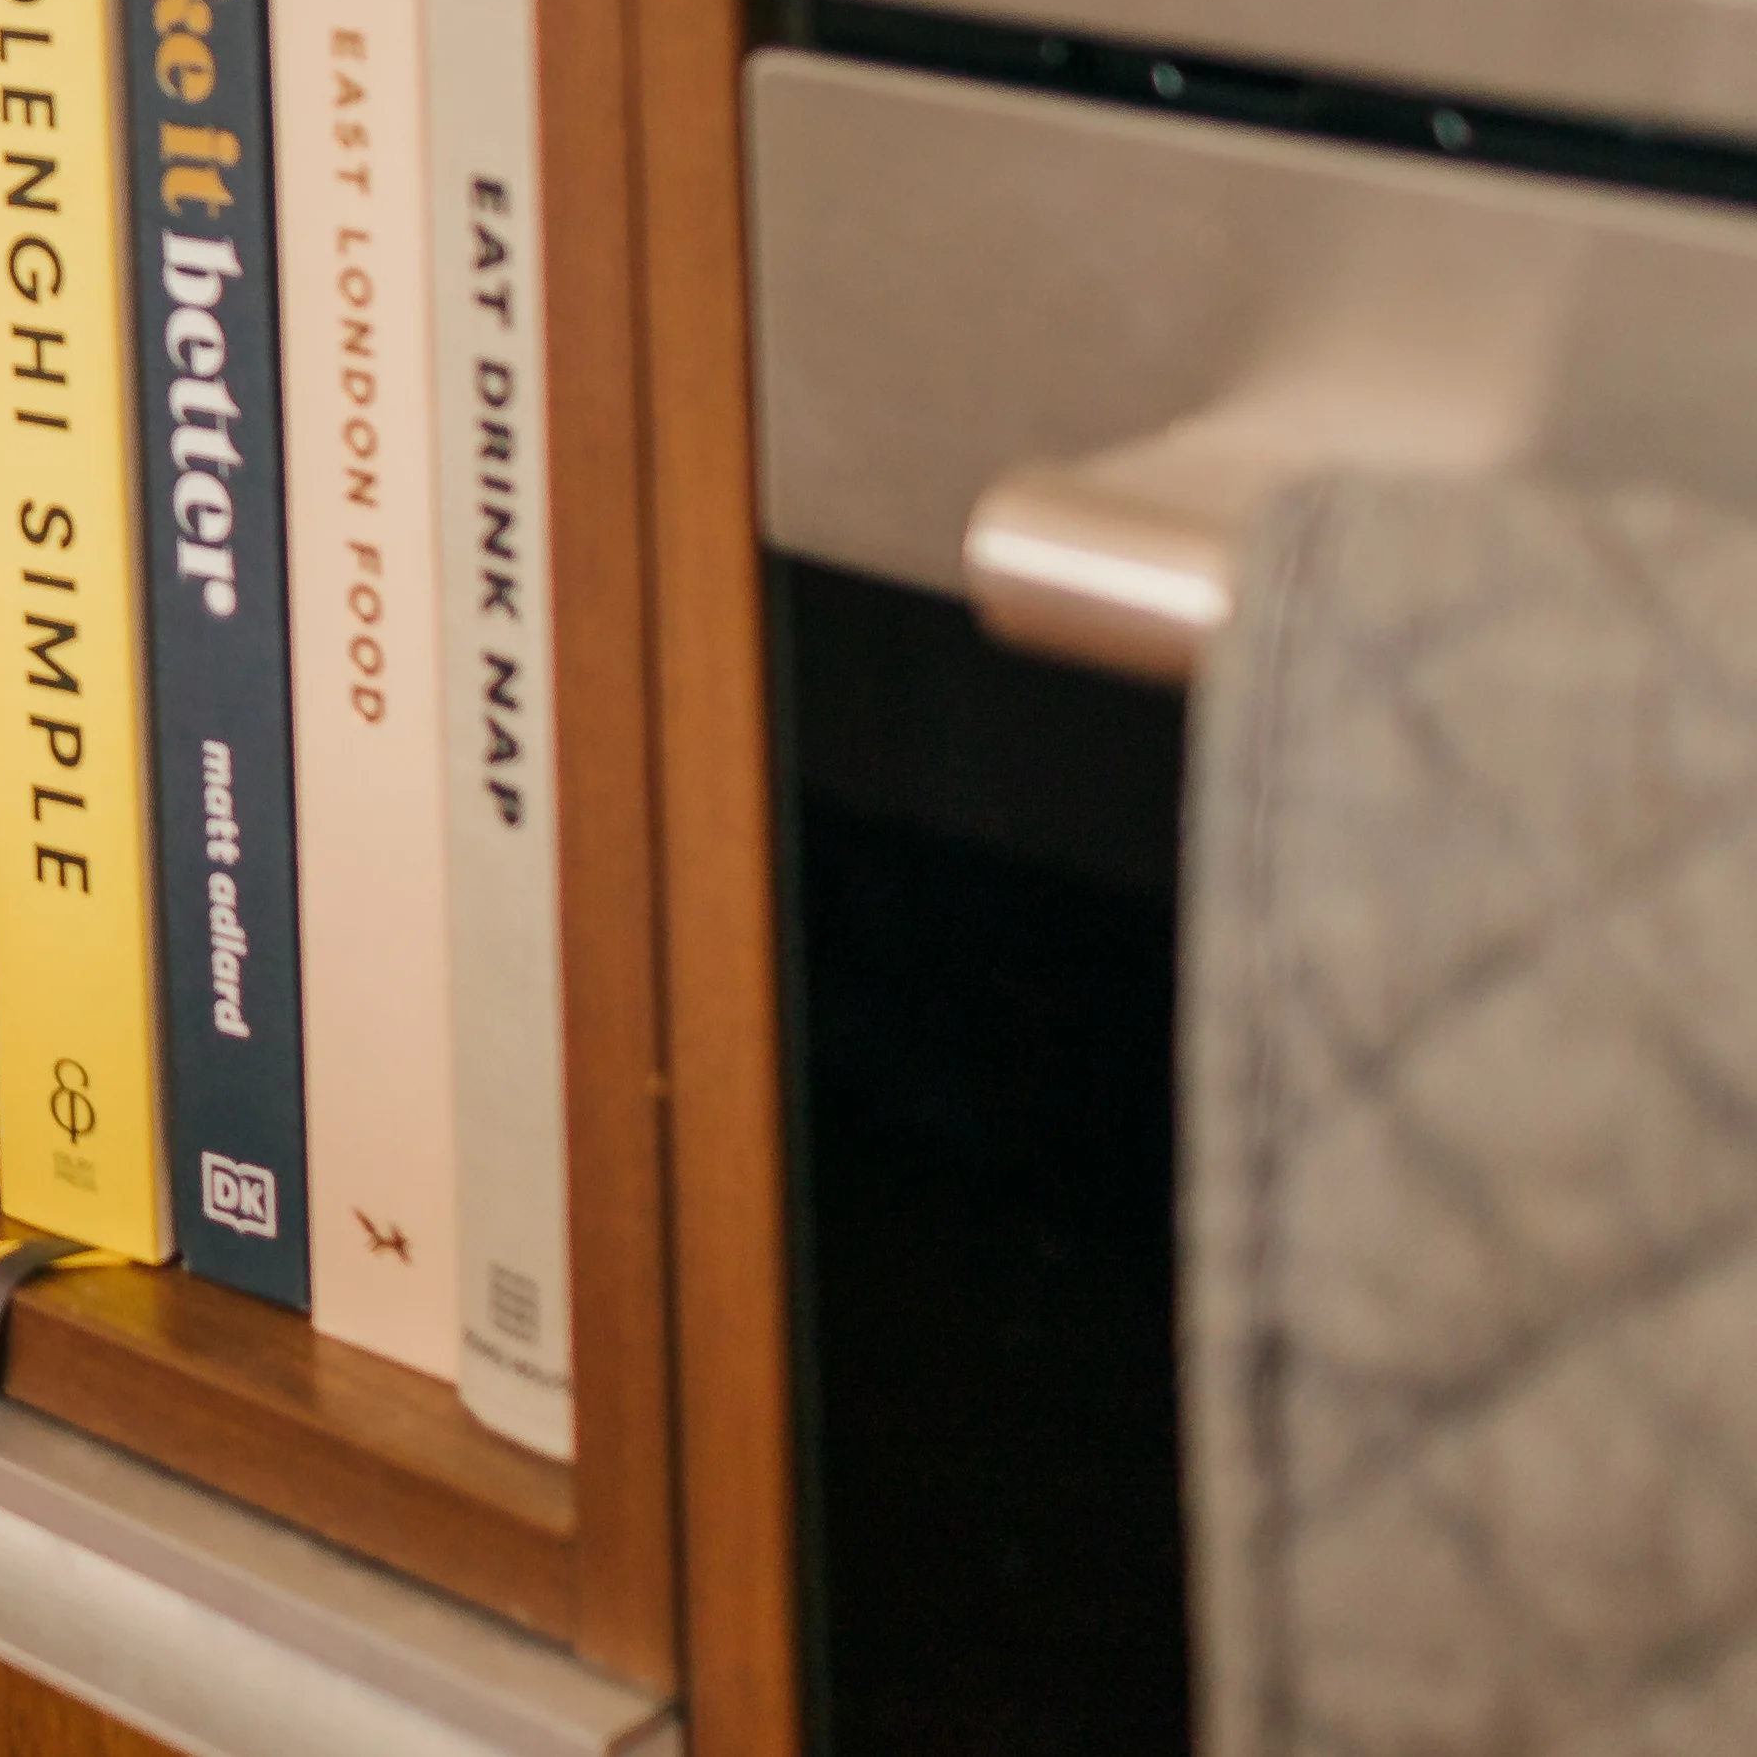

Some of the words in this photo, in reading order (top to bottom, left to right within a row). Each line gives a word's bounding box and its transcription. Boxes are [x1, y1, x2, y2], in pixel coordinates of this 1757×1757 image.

[159, 122, 241, 218] it
[330, 26, 371, 195] EAST
[471, 174, 512, 329] EAT
[163, 229, 243, 620] better
[336, 227, 379, 510] LONDON
[475, 360, 519, 620] DRINK
[20, 498, 91, 897] SIMPLE
[345, 540, 386, 725] FOOD
[201, 738, 242, 866] matt
[481, 650, 523, 828] NAP
[209, 872, 250, 1038] adlard
[213, 1171, 265, 1221] DK
